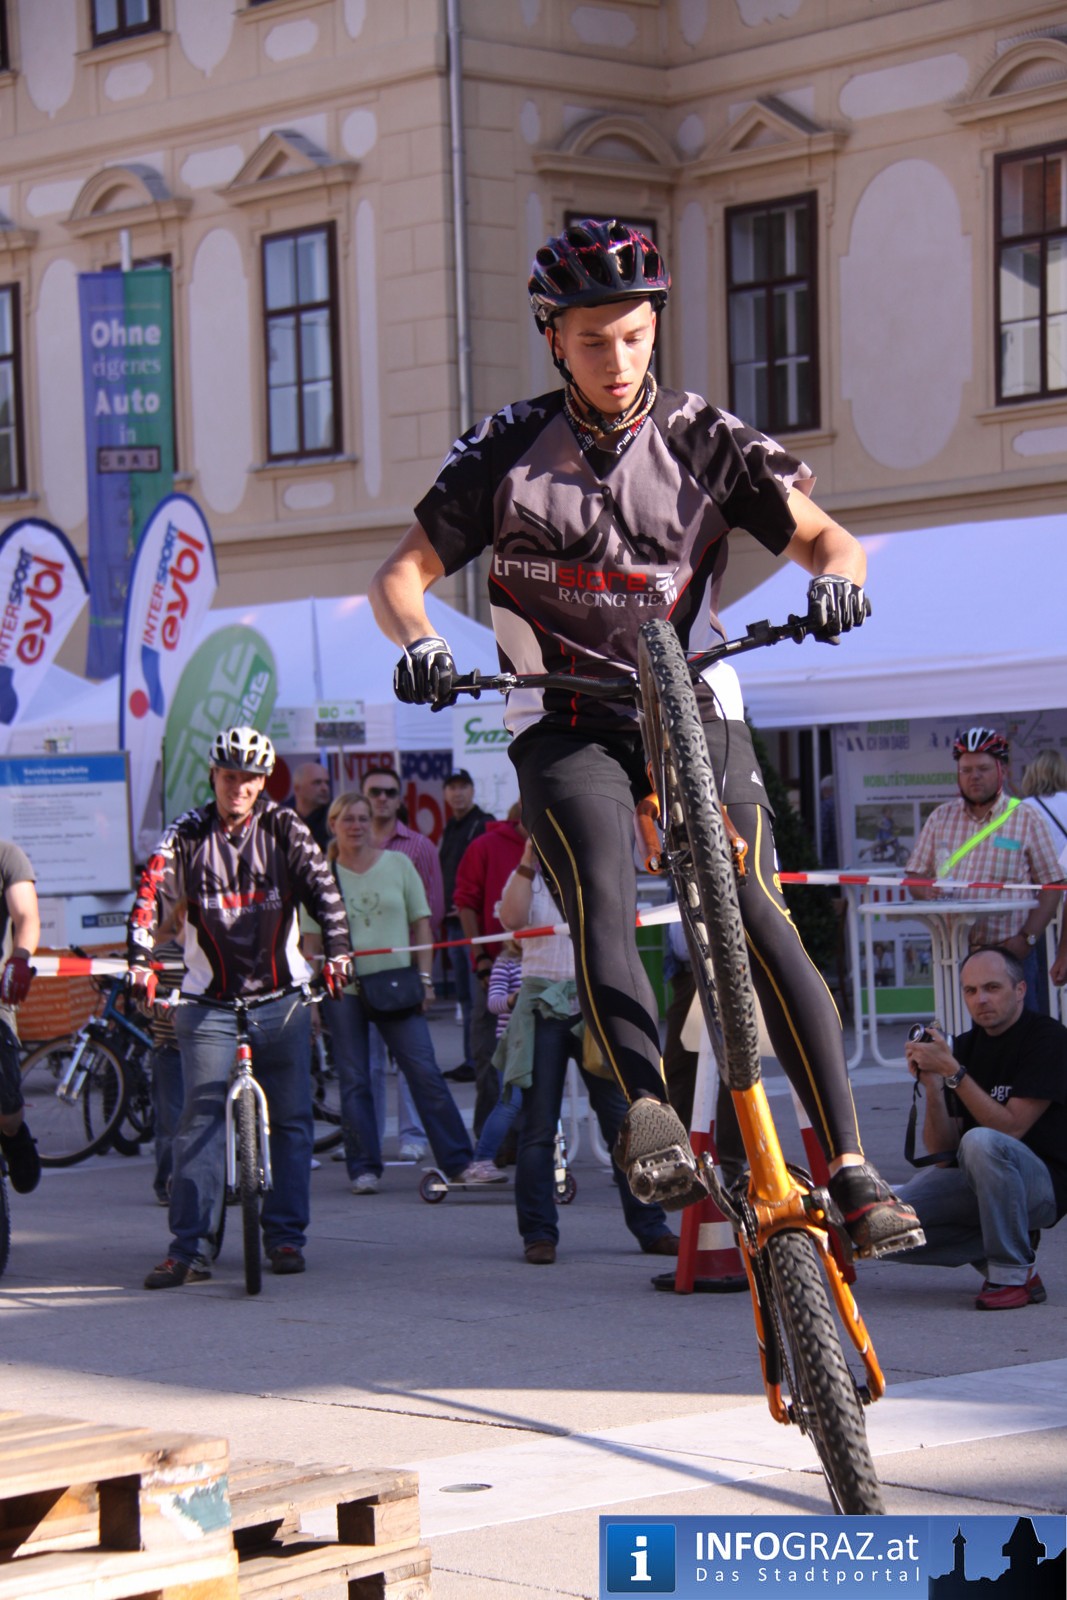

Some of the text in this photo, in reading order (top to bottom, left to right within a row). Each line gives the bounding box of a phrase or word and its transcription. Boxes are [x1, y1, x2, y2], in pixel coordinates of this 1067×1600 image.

[91, 318, 162, 347] Ohne
[92, 355, 162, 382] eigenes
[95, 388, 160, 416] Auto
[119, 424, 137, 444] in
[142, 519, 181, 645] INTERSPORT
[161, 530, 205, 651] eybl
[16, 555, 64, 666] eybl
[558, 588, 679, 608] RACING TEAM
[464, 717, 512, 745] Graz
